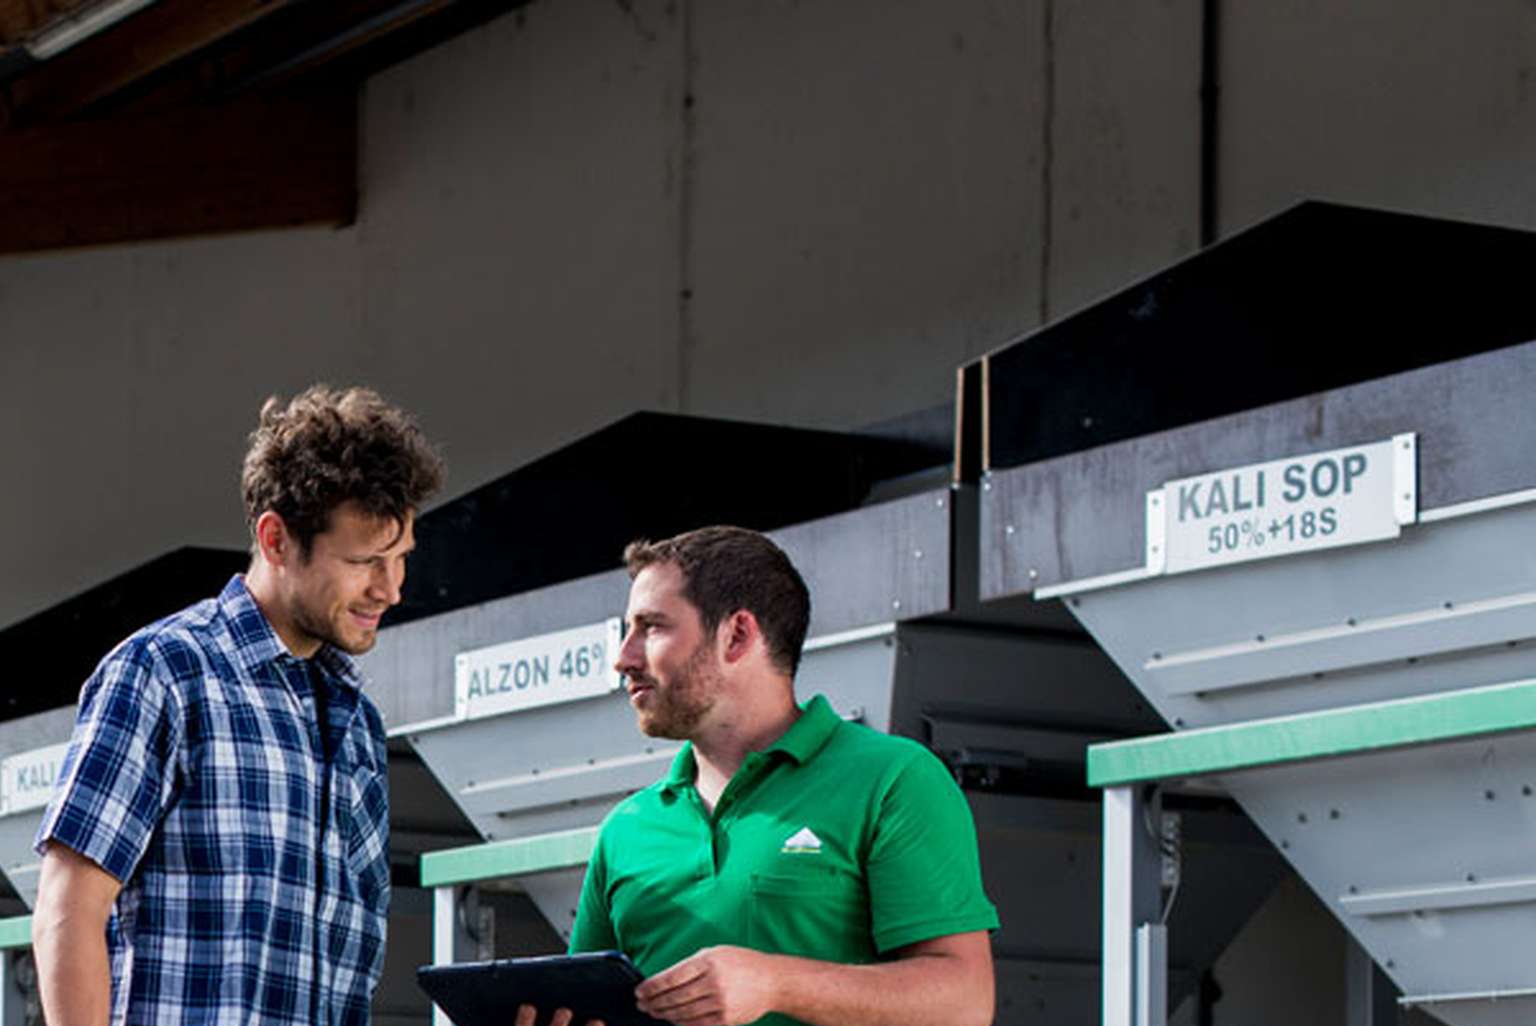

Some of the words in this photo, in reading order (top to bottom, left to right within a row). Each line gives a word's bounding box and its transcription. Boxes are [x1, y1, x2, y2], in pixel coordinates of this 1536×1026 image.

[1178, 471, 1265, 523] KALI
[1282, 453, 1368, 503] SOP
[1207, 507, 1338, 553] 50%+18S
[467, 655, 549, 699] ALZON
[16, 761, 55, 793] KALI
